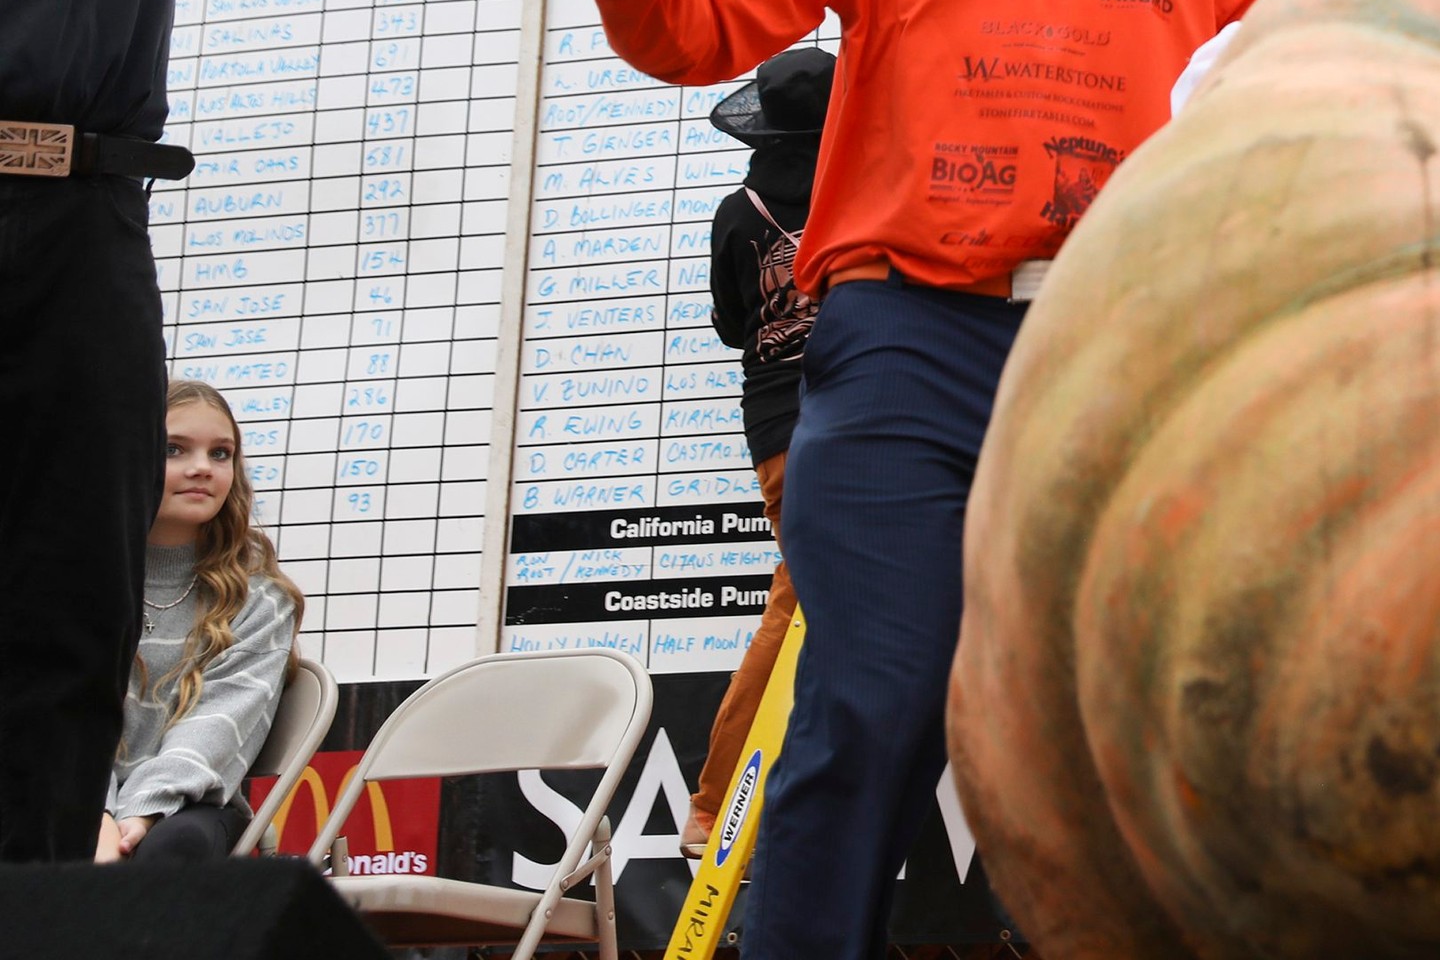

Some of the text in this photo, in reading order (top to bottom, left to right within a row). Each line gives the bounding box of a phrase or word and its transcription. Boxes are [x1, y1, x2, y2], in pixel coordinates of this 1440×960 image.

[371, 76, 415, 97] 473
[368, 110, 410, 135] 437
[366, 146, 404, 168] 581
[1041, 136, 1125, 166] Neptune'
[196, 191, 284, 216] AUBURN
[365, 180, 403, 202] 292
[366, 213, 400, 236] 377
[570, 270, 661, 294] MILLER
[188, 296, 229, 318] SAN
[236, 293, 286, 315] JOSE
[568, 304, 656, 329] VENTERS
[223, 327, 267, 347] JOSE
[227, 362, 288, 381] MATEO
[367, 353, 391, 376] 88
[571, 343, 632, 366] CHAN
[348, 386, 388, 407] 286
[344, 421, 384, 446] 170
[564, 410, 643, 435] EWING
[665, 408, 741, 429] KIRKLA
[340, 458, 380, 479] 150
[564, 447, 645, 472] CARTER
[348, 493, 373, 514] 93
[554, 484, 645, 508] WARNER
[669, 476, 762, 497] GRIDLE
[609, 514, 716, 539] California
[604, 587, 715, 611] Coastside
[654, 633, 695, 655] HALF
[704, 627, 741, 651] MOON
[724, 772, 754, 842] WERNER
[678, 884, 720, 960] MIRA
